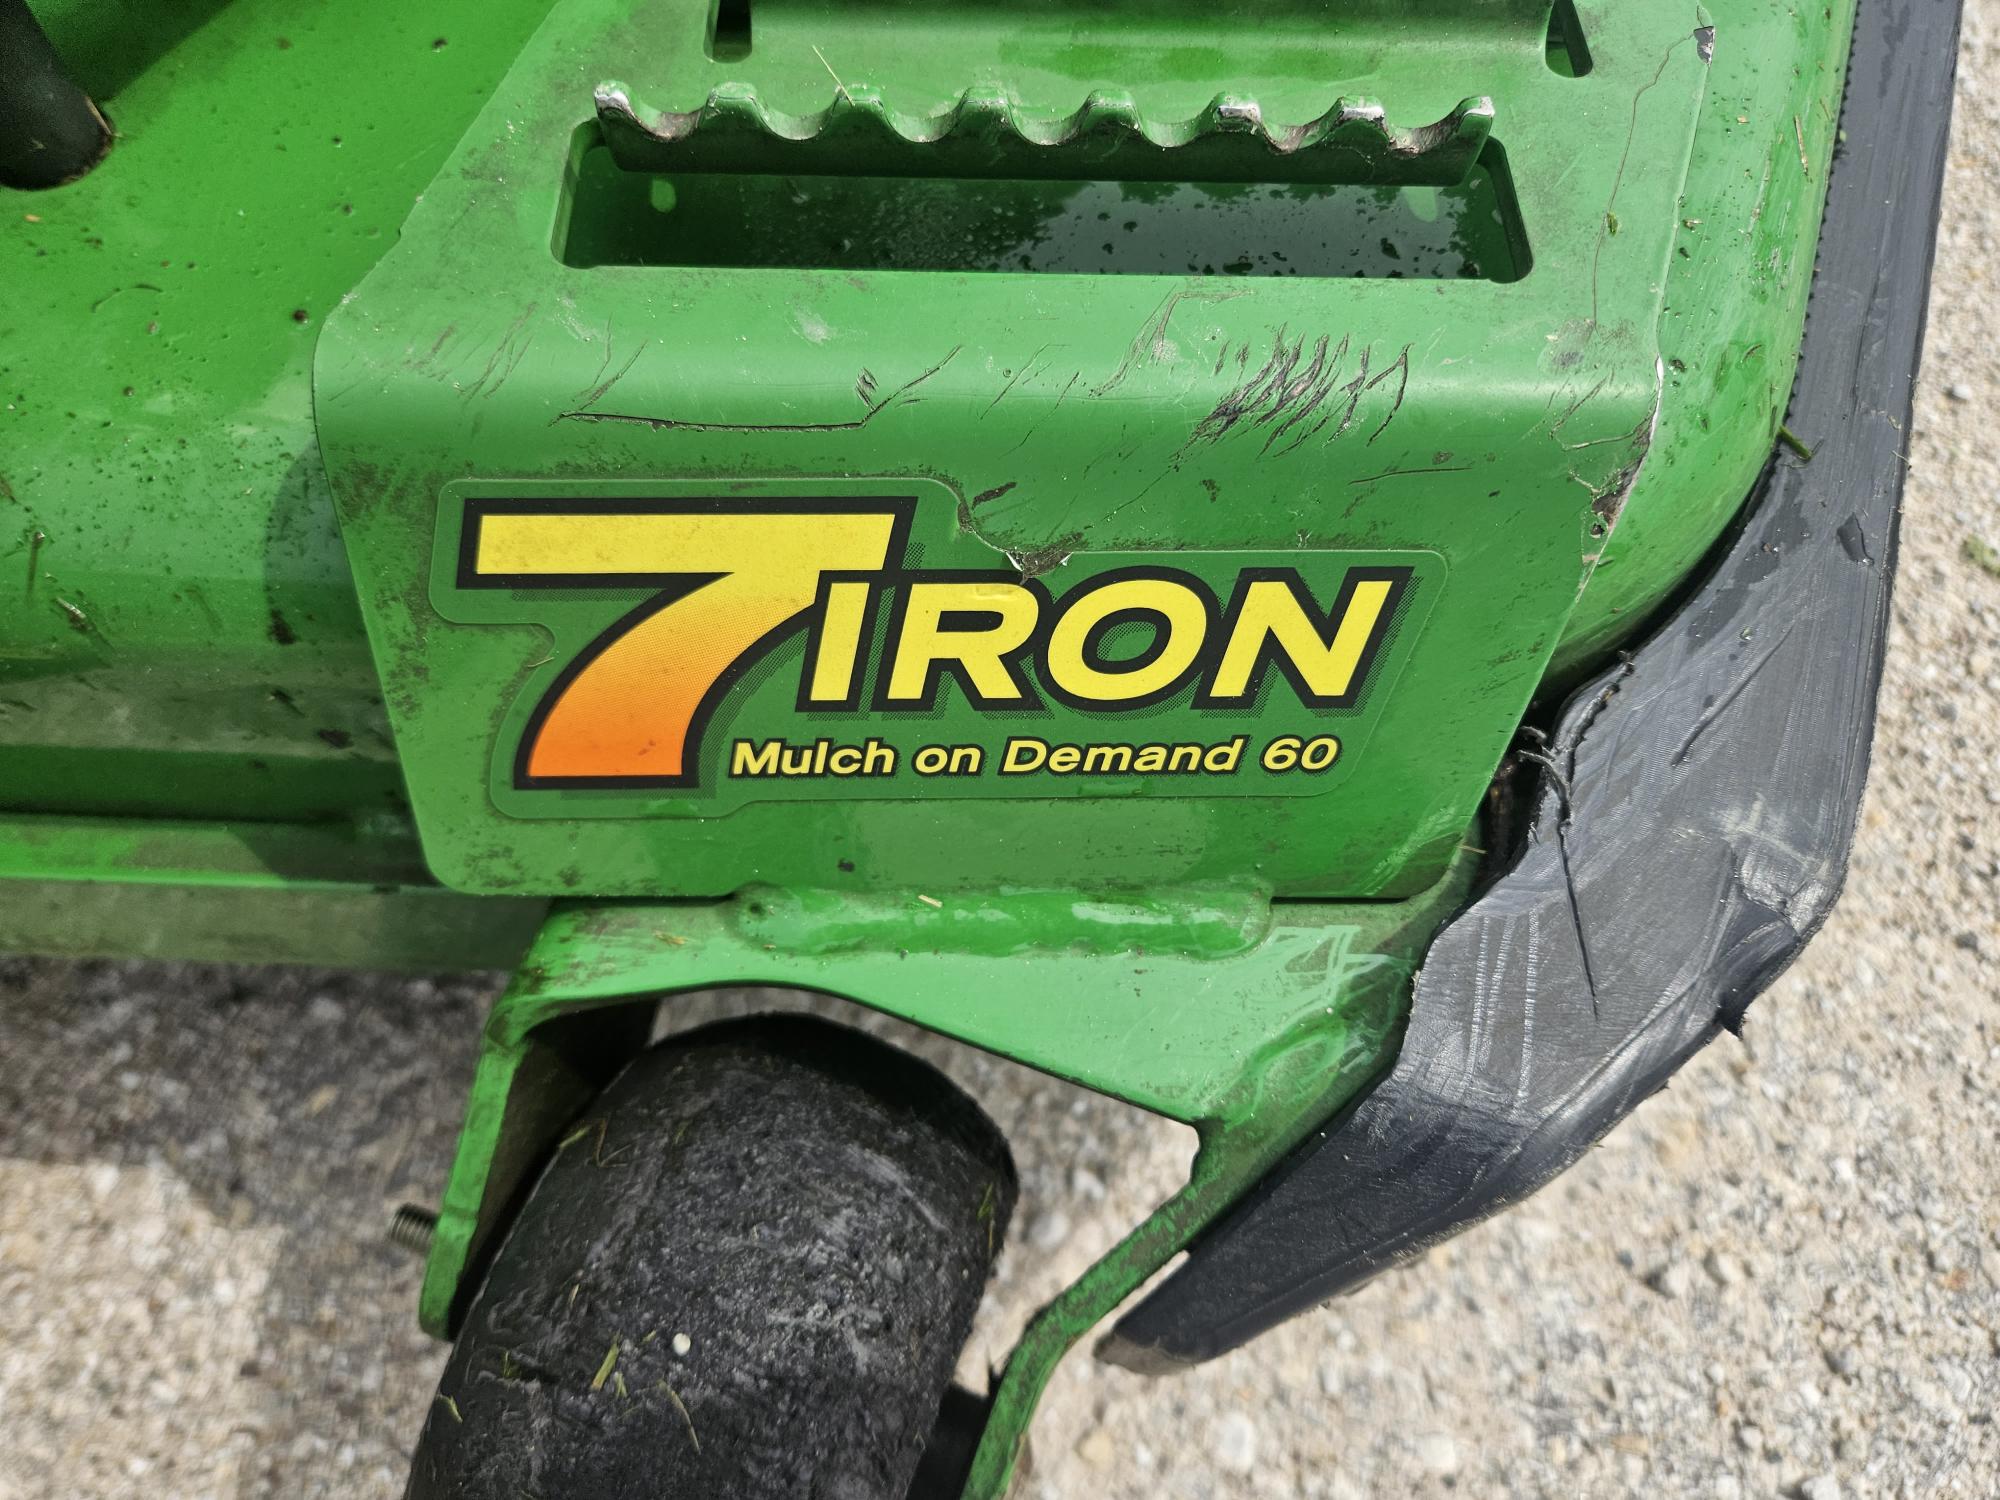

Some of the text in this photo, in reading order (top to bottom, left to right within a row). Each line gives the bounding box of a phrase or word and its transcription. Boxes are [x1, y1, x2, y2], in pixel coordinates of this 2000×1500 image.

[731, 736, 1340, 777] Mulch on Demand 60
